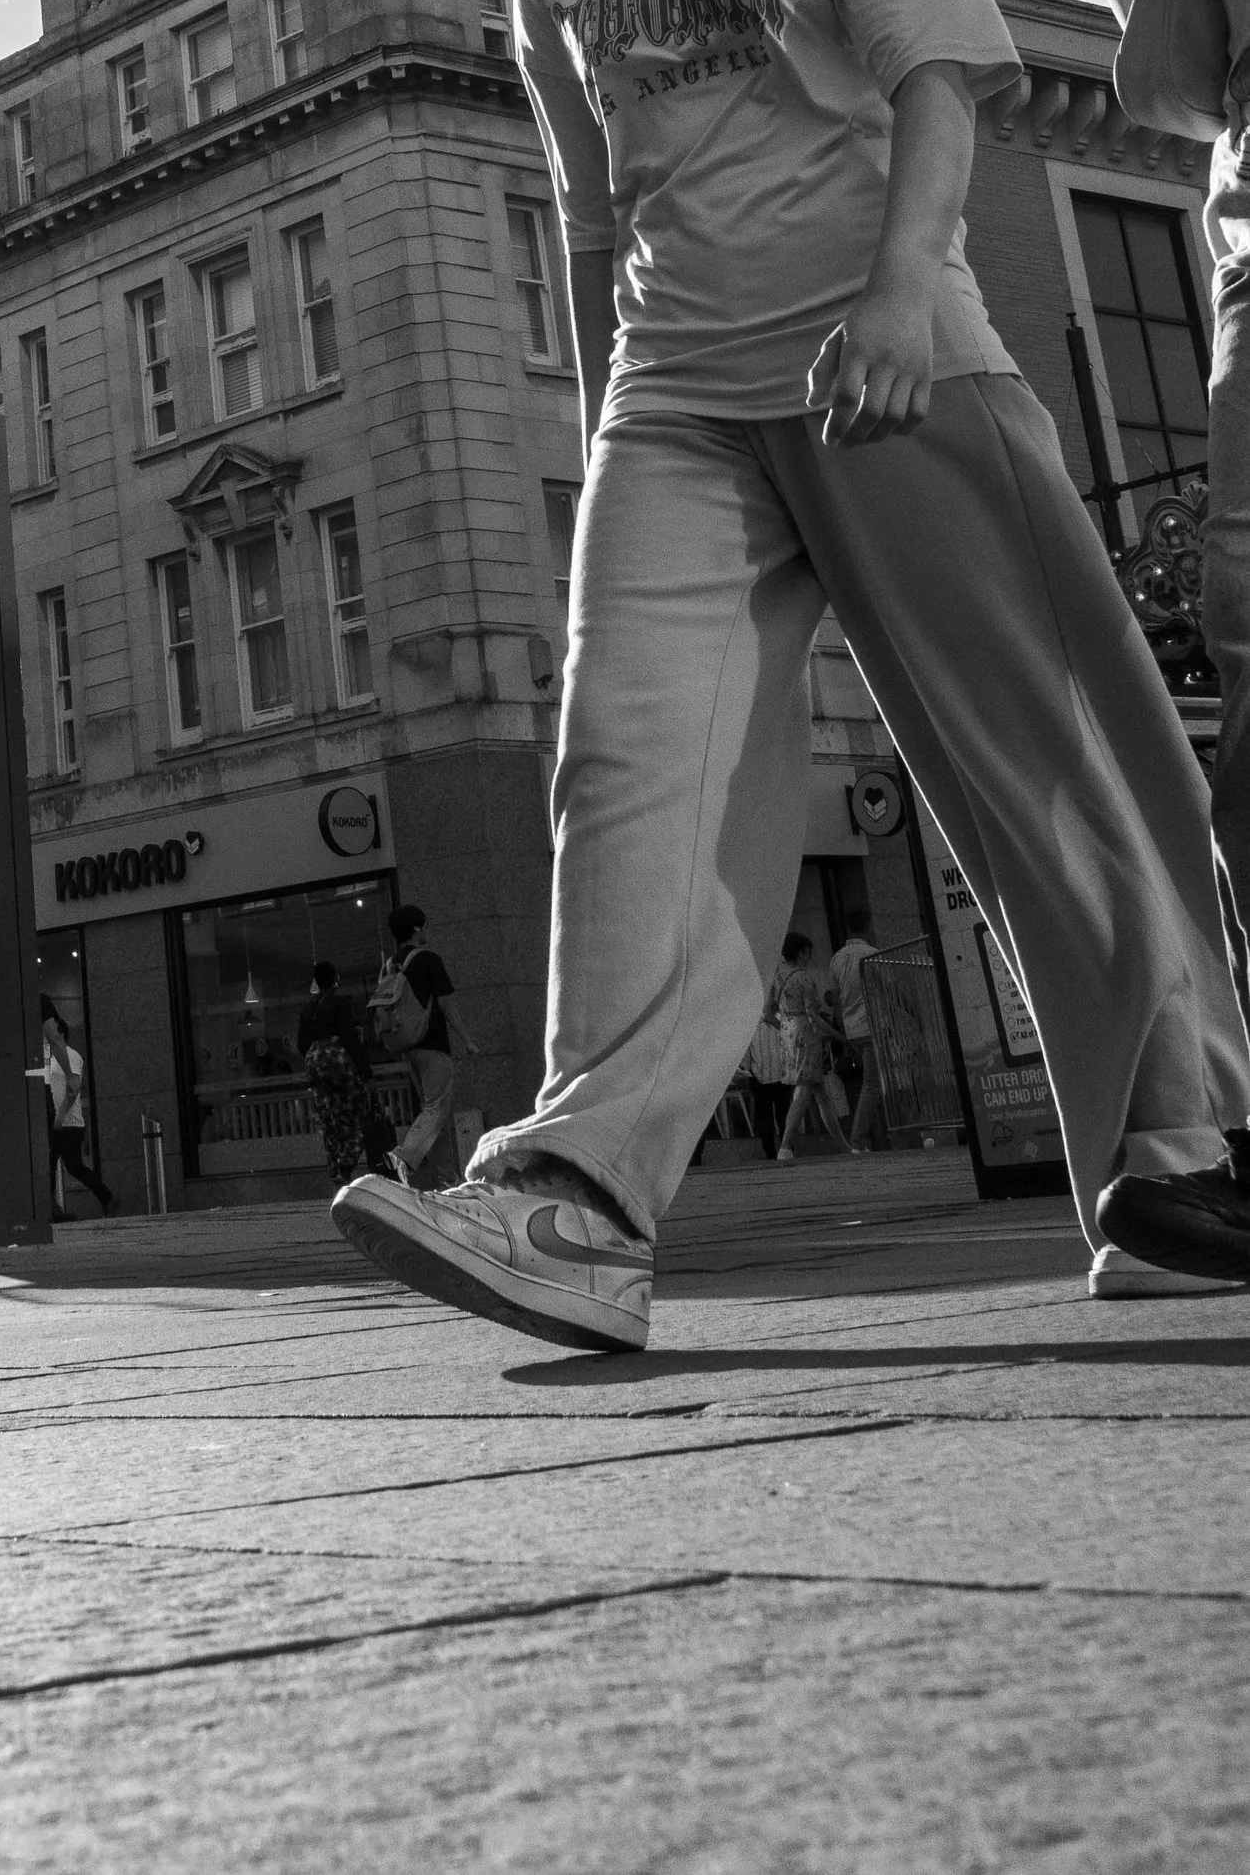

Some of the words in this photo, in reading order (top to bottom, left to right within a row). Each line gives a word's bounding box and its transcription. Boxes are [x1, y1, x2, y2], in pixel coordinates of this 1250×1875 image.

[332, 815, 368, 828] KOKORO
[54, 838, 188, 903] KOKORO
[946, 890, 977, 911] DRO
[980, 1072, 1019, 1090] LITTER
[984, 1090, 1007, 1107] CAN
[1008, 1088, 1031, 1105] END
[1033, 1086, 1048, 1102] UP
